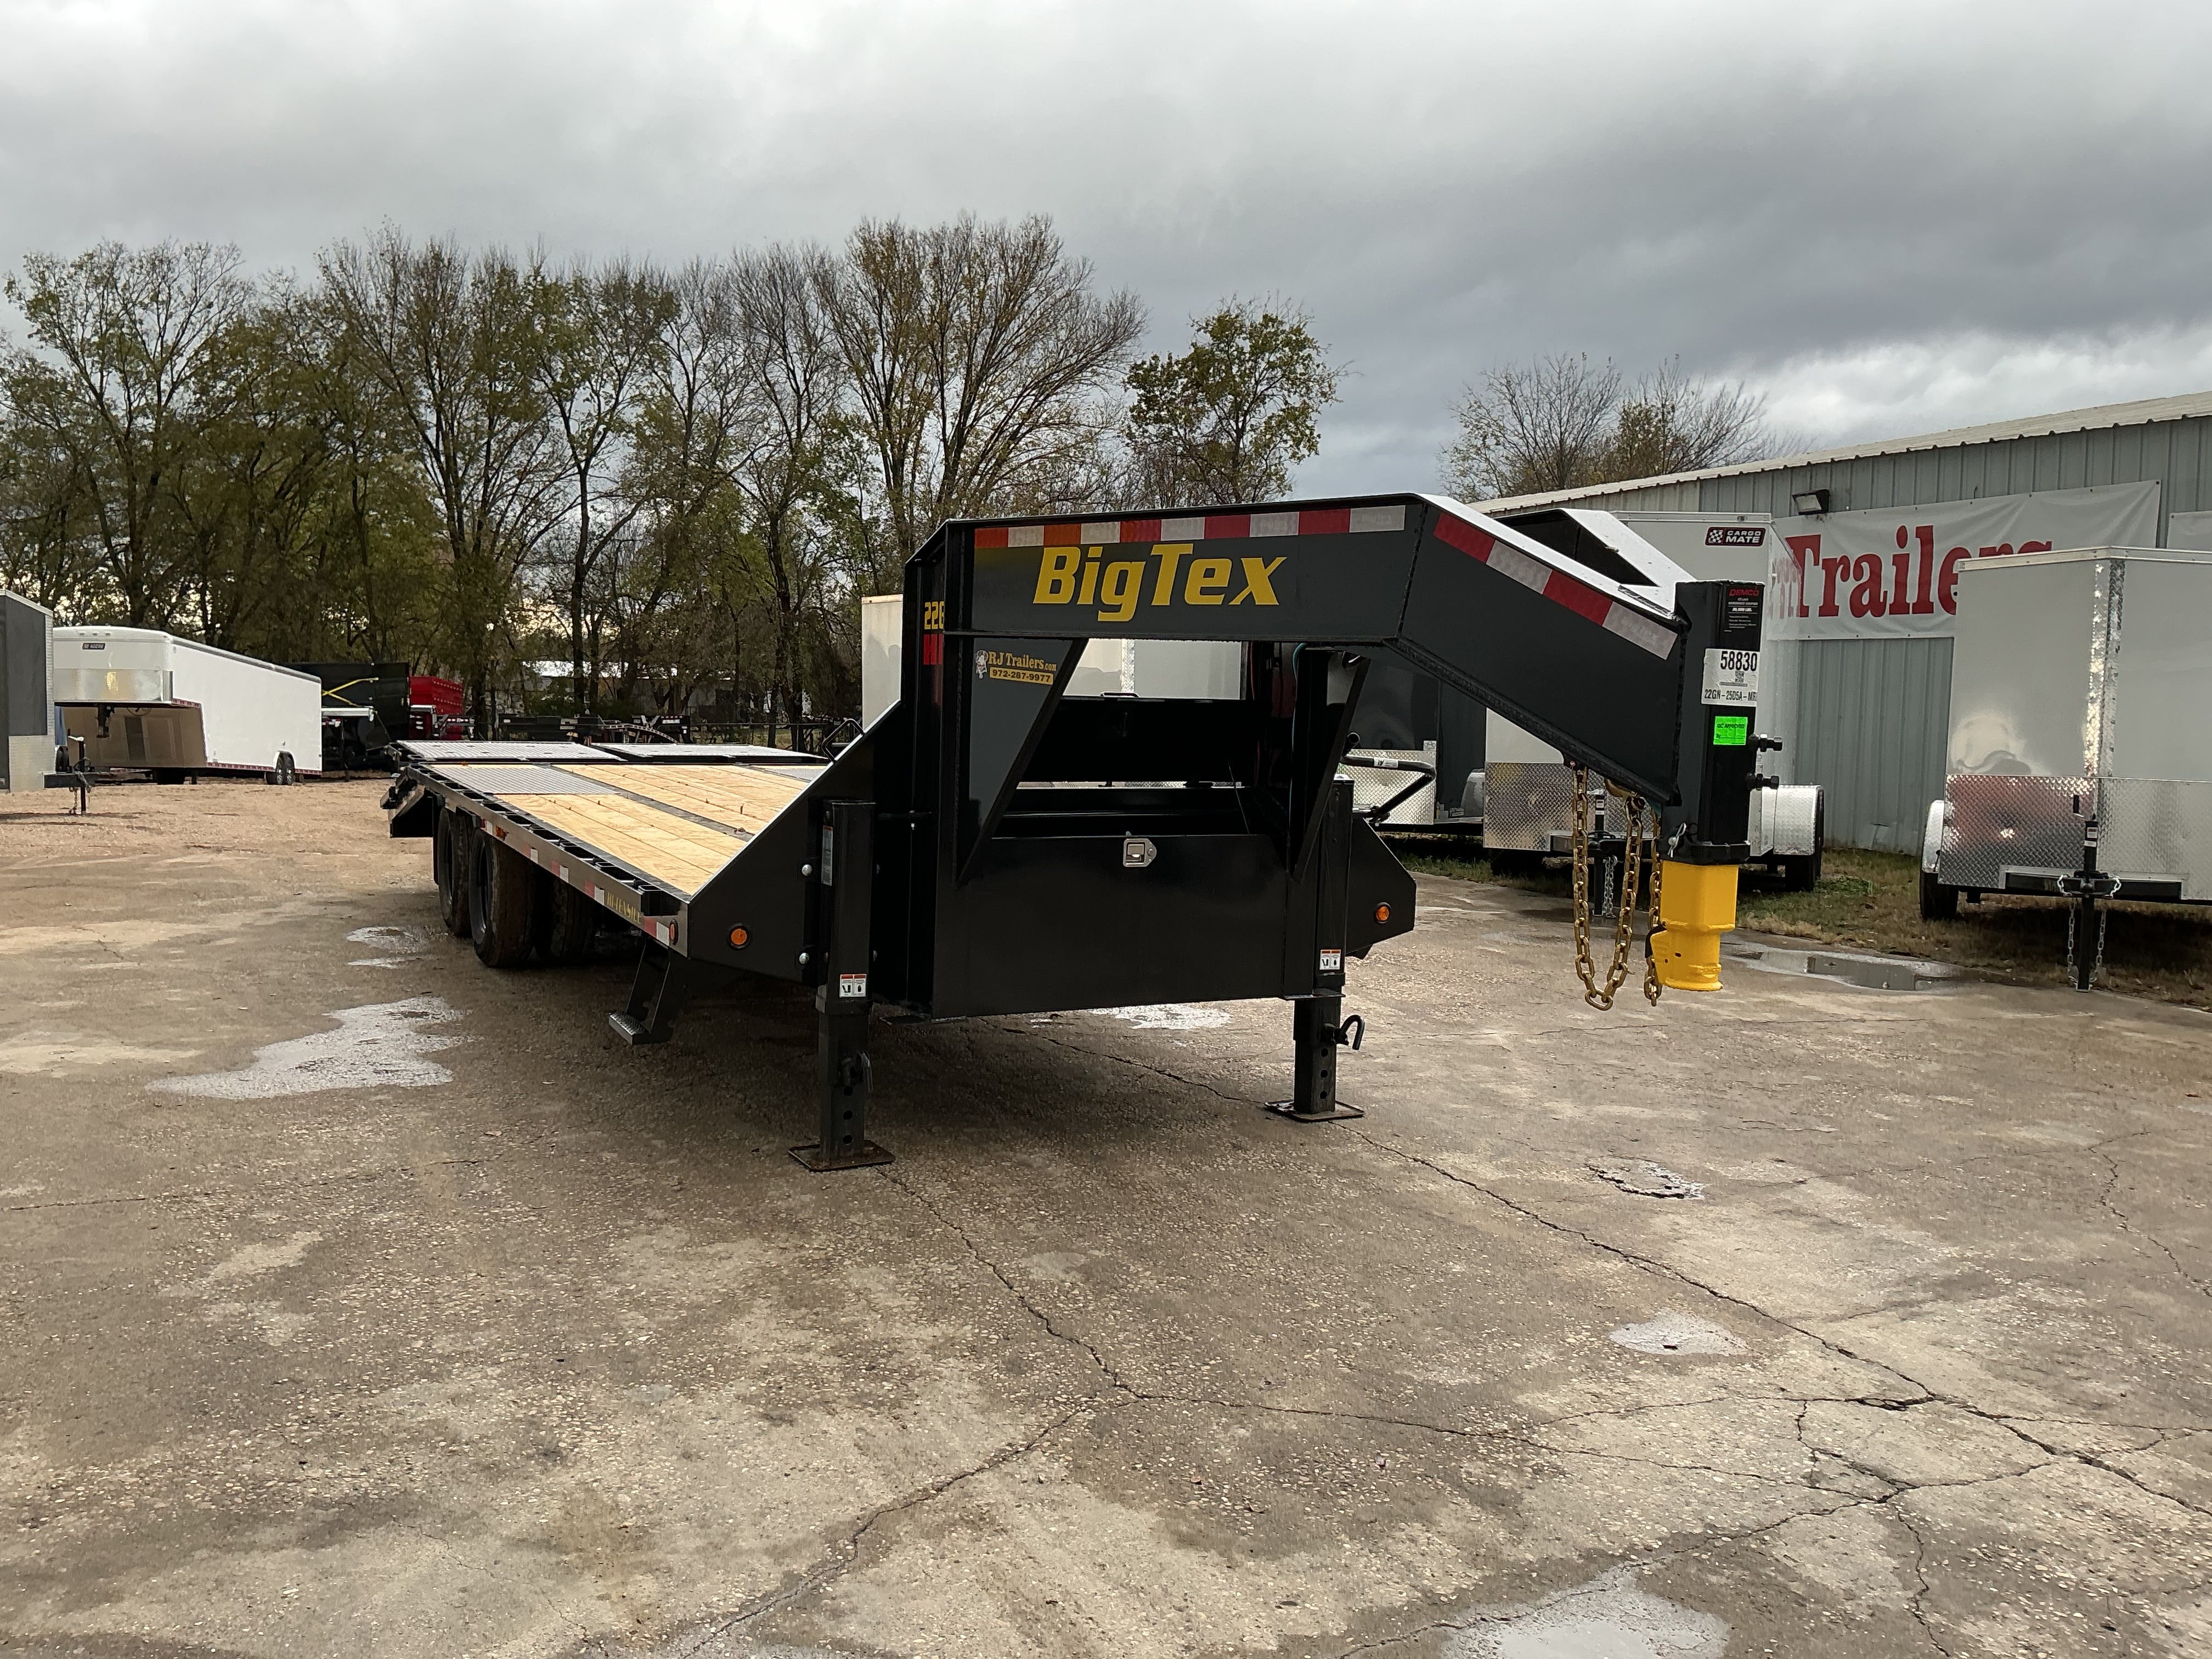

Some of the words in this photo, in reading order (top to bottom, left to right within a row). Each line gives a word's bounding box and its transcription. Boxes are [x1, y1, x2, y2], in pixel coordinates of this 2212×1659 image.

[1785, 524, 2052, 618] Traile
[1720, 651, 1758, 672] 58830
[992, 669, 1051, 682] 972-287-9977
